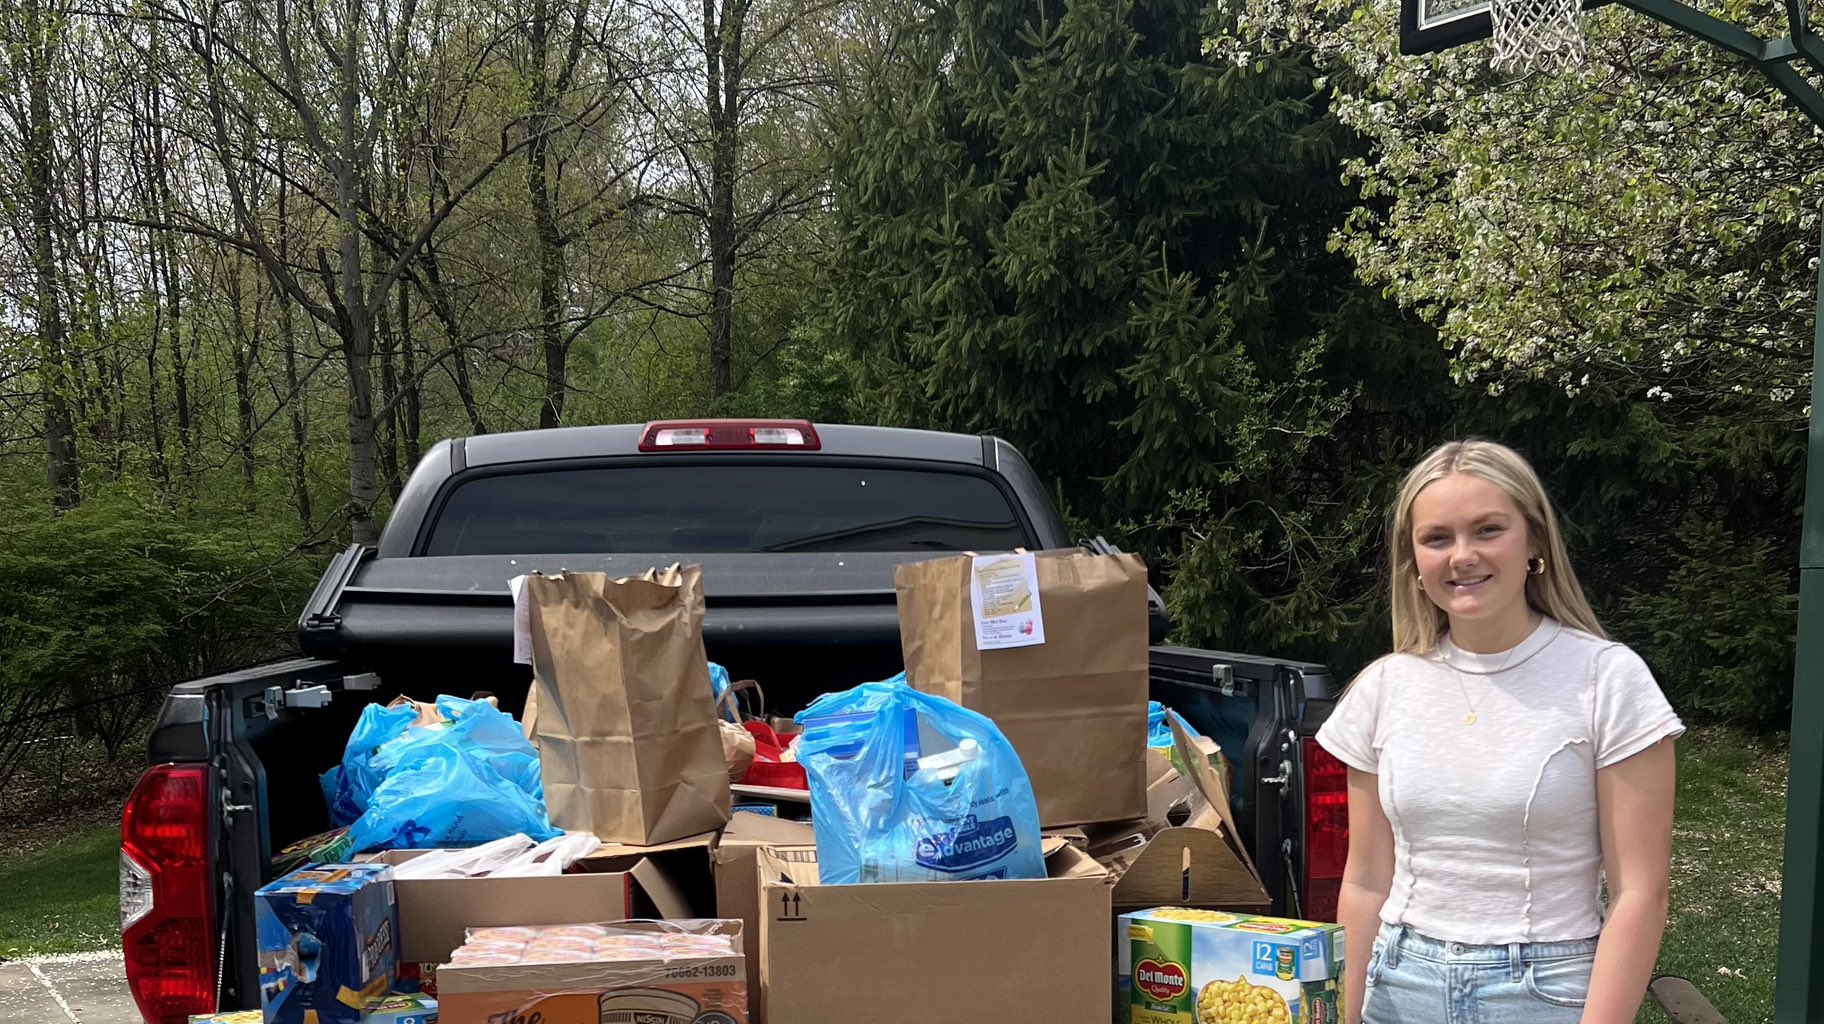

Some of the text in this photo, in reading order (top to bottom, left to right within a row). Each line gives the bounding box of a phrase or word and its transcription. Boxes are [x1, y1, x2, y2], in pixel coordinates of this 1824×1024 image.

[1256, 943, 1273, 962] 12
[1255, 961, 1273, 972] CANS
[1139, 969, 1184, 987] Del Monte
